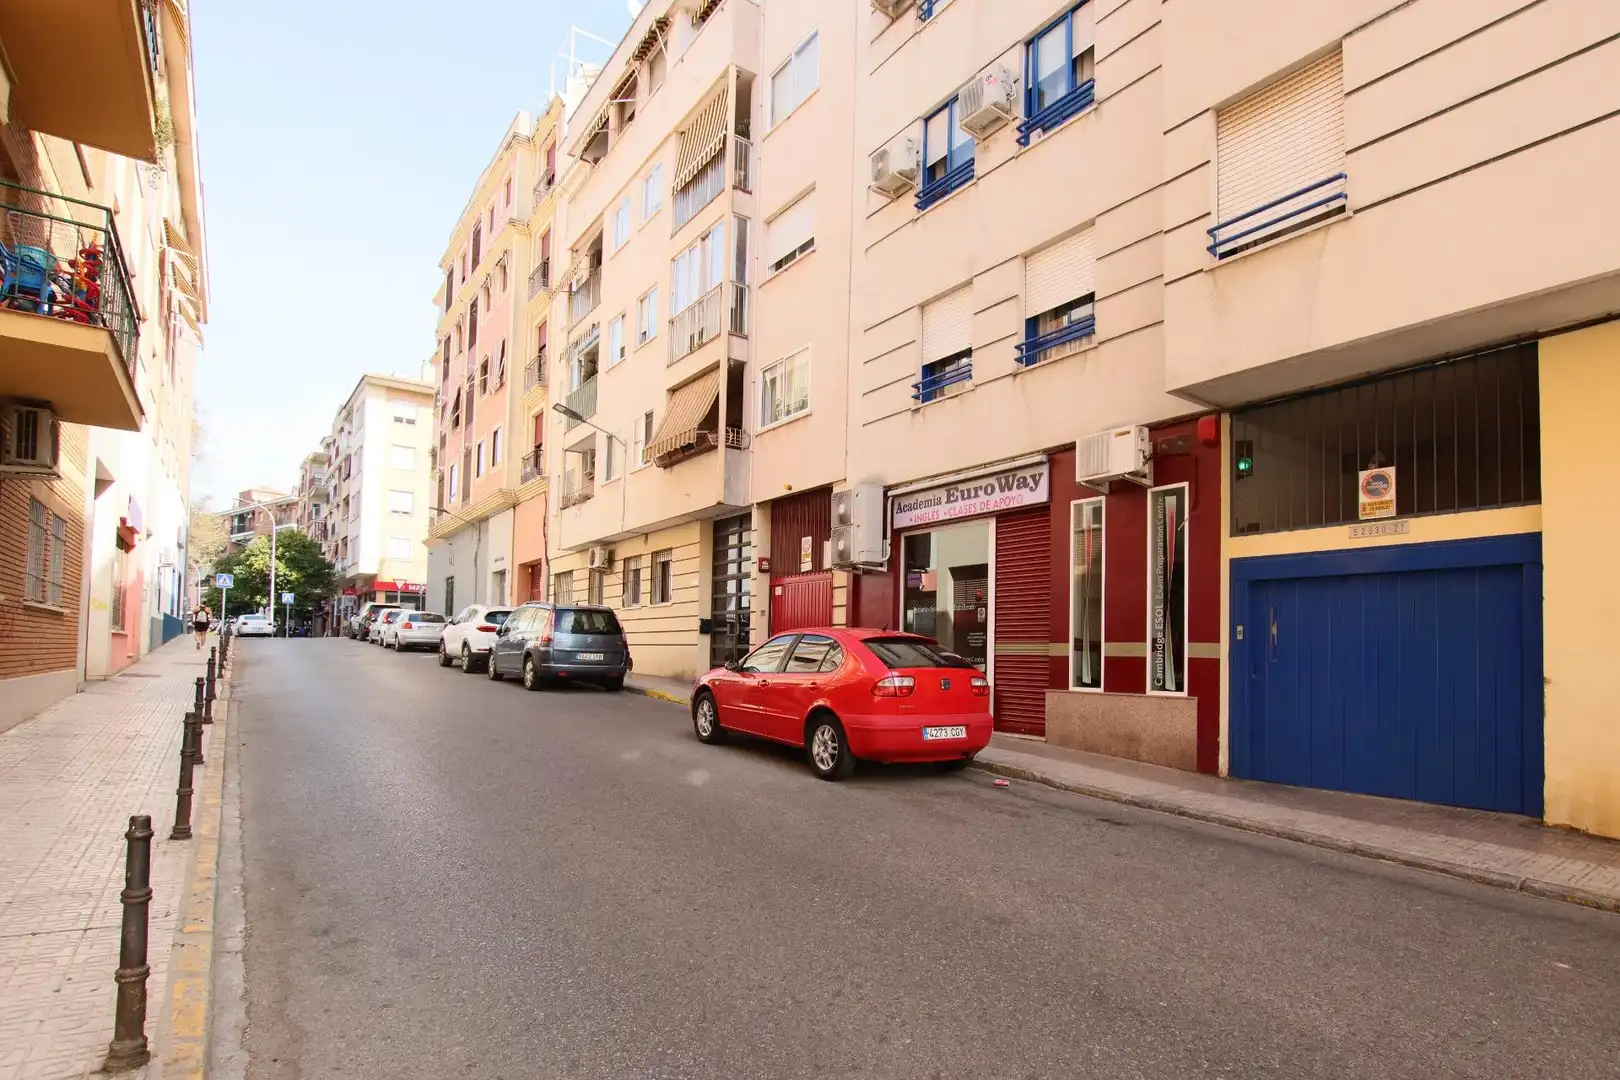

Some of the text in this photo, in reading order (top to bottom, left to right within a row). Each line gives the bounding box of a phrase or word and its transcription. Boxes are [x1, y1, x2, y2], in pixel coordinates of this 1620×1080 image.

[896, 472, 1044, 515] Academia EuroWay
[948, 503, 977, 518] CLASES
[980, 501, 991, 512] DE
[993, 494, 1024, 510] APOYO
[1156, 523, 1165, 574] Preparation
[1156, 575, 1164, 600] Exam
[1155, 604, 1164, 630] ESOL
[1154, 631, 1165, 686] Cambridge
[929, 727, 964, 738] 4273 CGY
